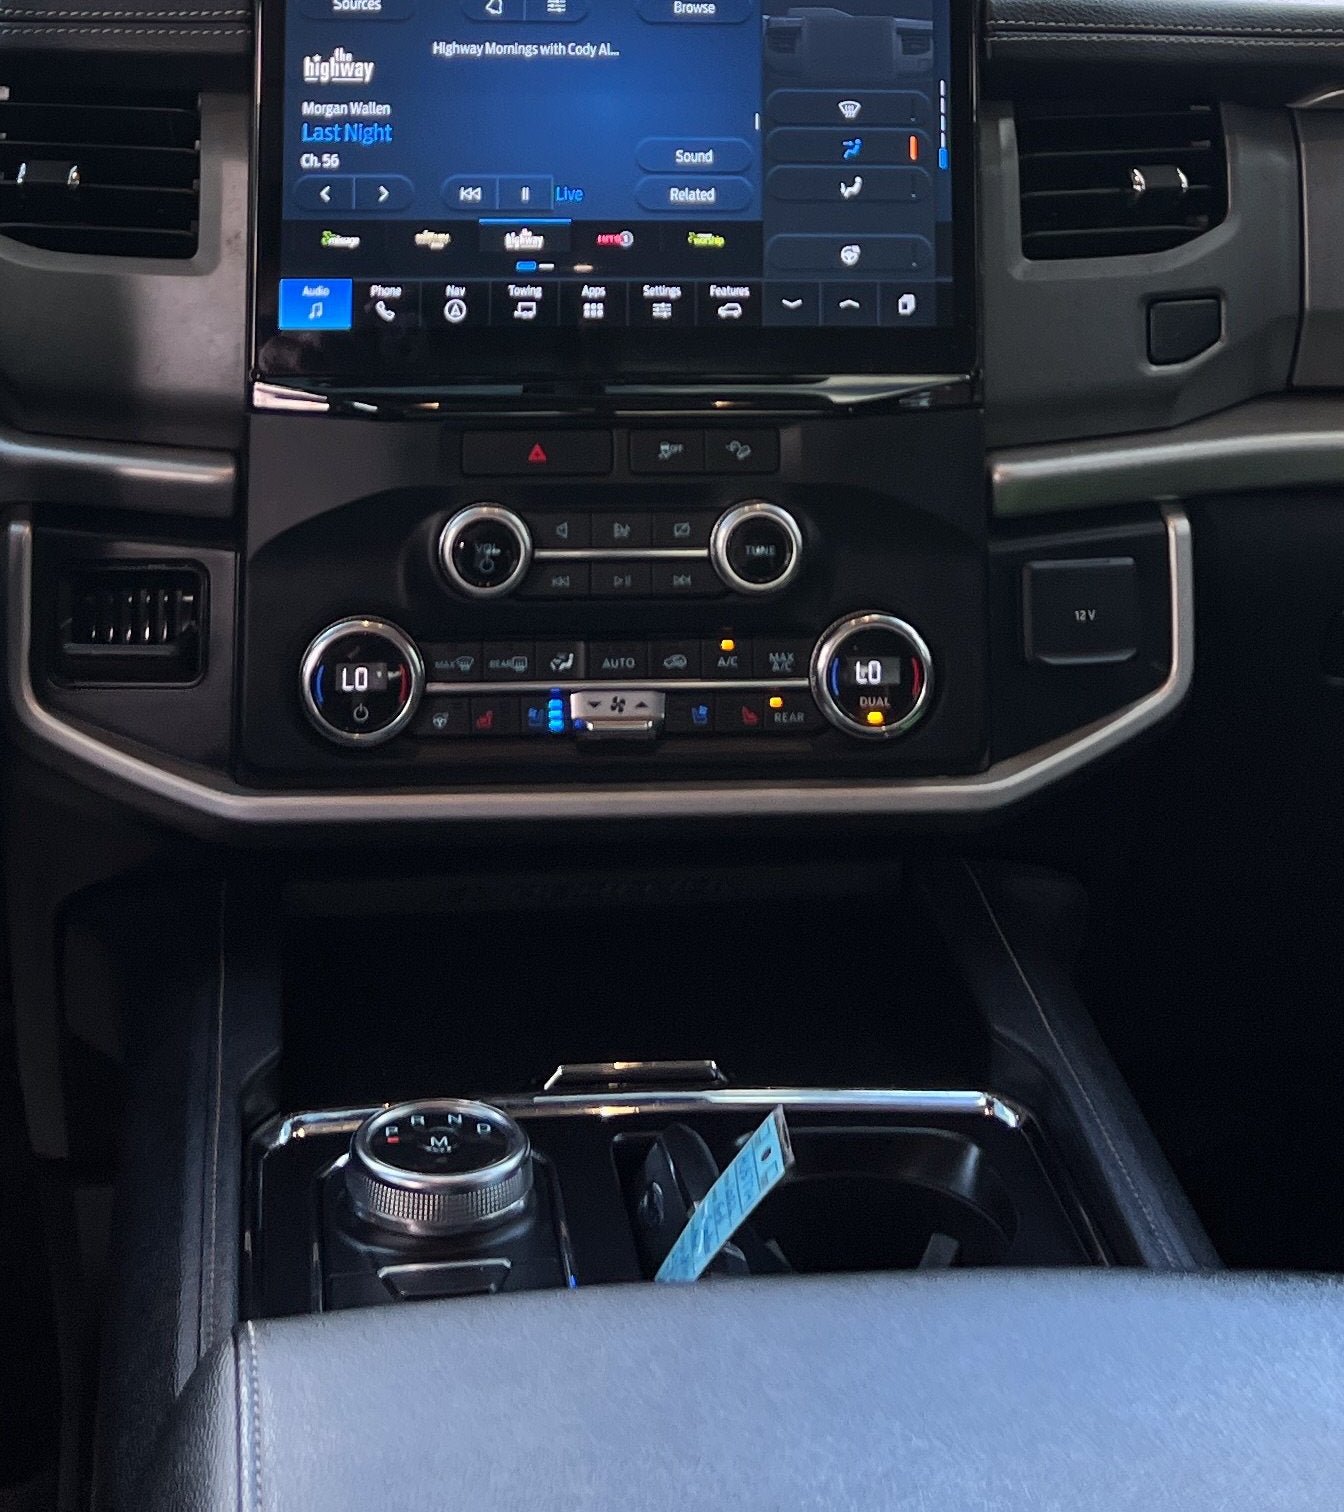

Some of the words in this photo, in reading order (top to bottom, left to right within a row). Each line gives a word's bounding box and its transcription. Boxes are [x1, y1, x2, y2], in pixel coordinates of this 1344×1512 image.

[673, 0, 716, 15] Browse
[334, 47, 353, 61] the
[432, 41, 484, 57] Highway
[485, 42, 538, 57] Mornings
[539, 42, 566, 56] with
[567, 42, 598, 57] Cody
[303, 54, 375, 85] highway
[302, 101, 348, 118] Morgan
[349, 101, 391, 116] Wallen
[301, 123, 342, 142] Last
[344, 123, 393, 145] Night
[322, 153, 340, 169] 56
[675, 149, 714, 163] Sound
[556, 186, 583, 202] Live
[670, 188, 716, 202] Related
[302, 285, 330, 297] Audio
[370, 285, 402, 297] Phone
[446, 285, 466, 297] Nav
[507, 285, 543, 300] Towing
[581, 285, 606, 299] Apps
[643, 284, 682, 300] Settings
[709, 285, 750, 297] Features
[475, 544, 499, 556] VOL
[745, 545, 775, 556] TUNE
[602, 657, 635, 669] AUTO
[717, 656, 738, 668] A/C
[769, 652, 794, 663] MAX
[859, 696, 891, 707] DUAL
[774, 711, 805, 723] REAR
[447, 1113, 463, 1125] N
[430, 1136, 449, 1149] M
